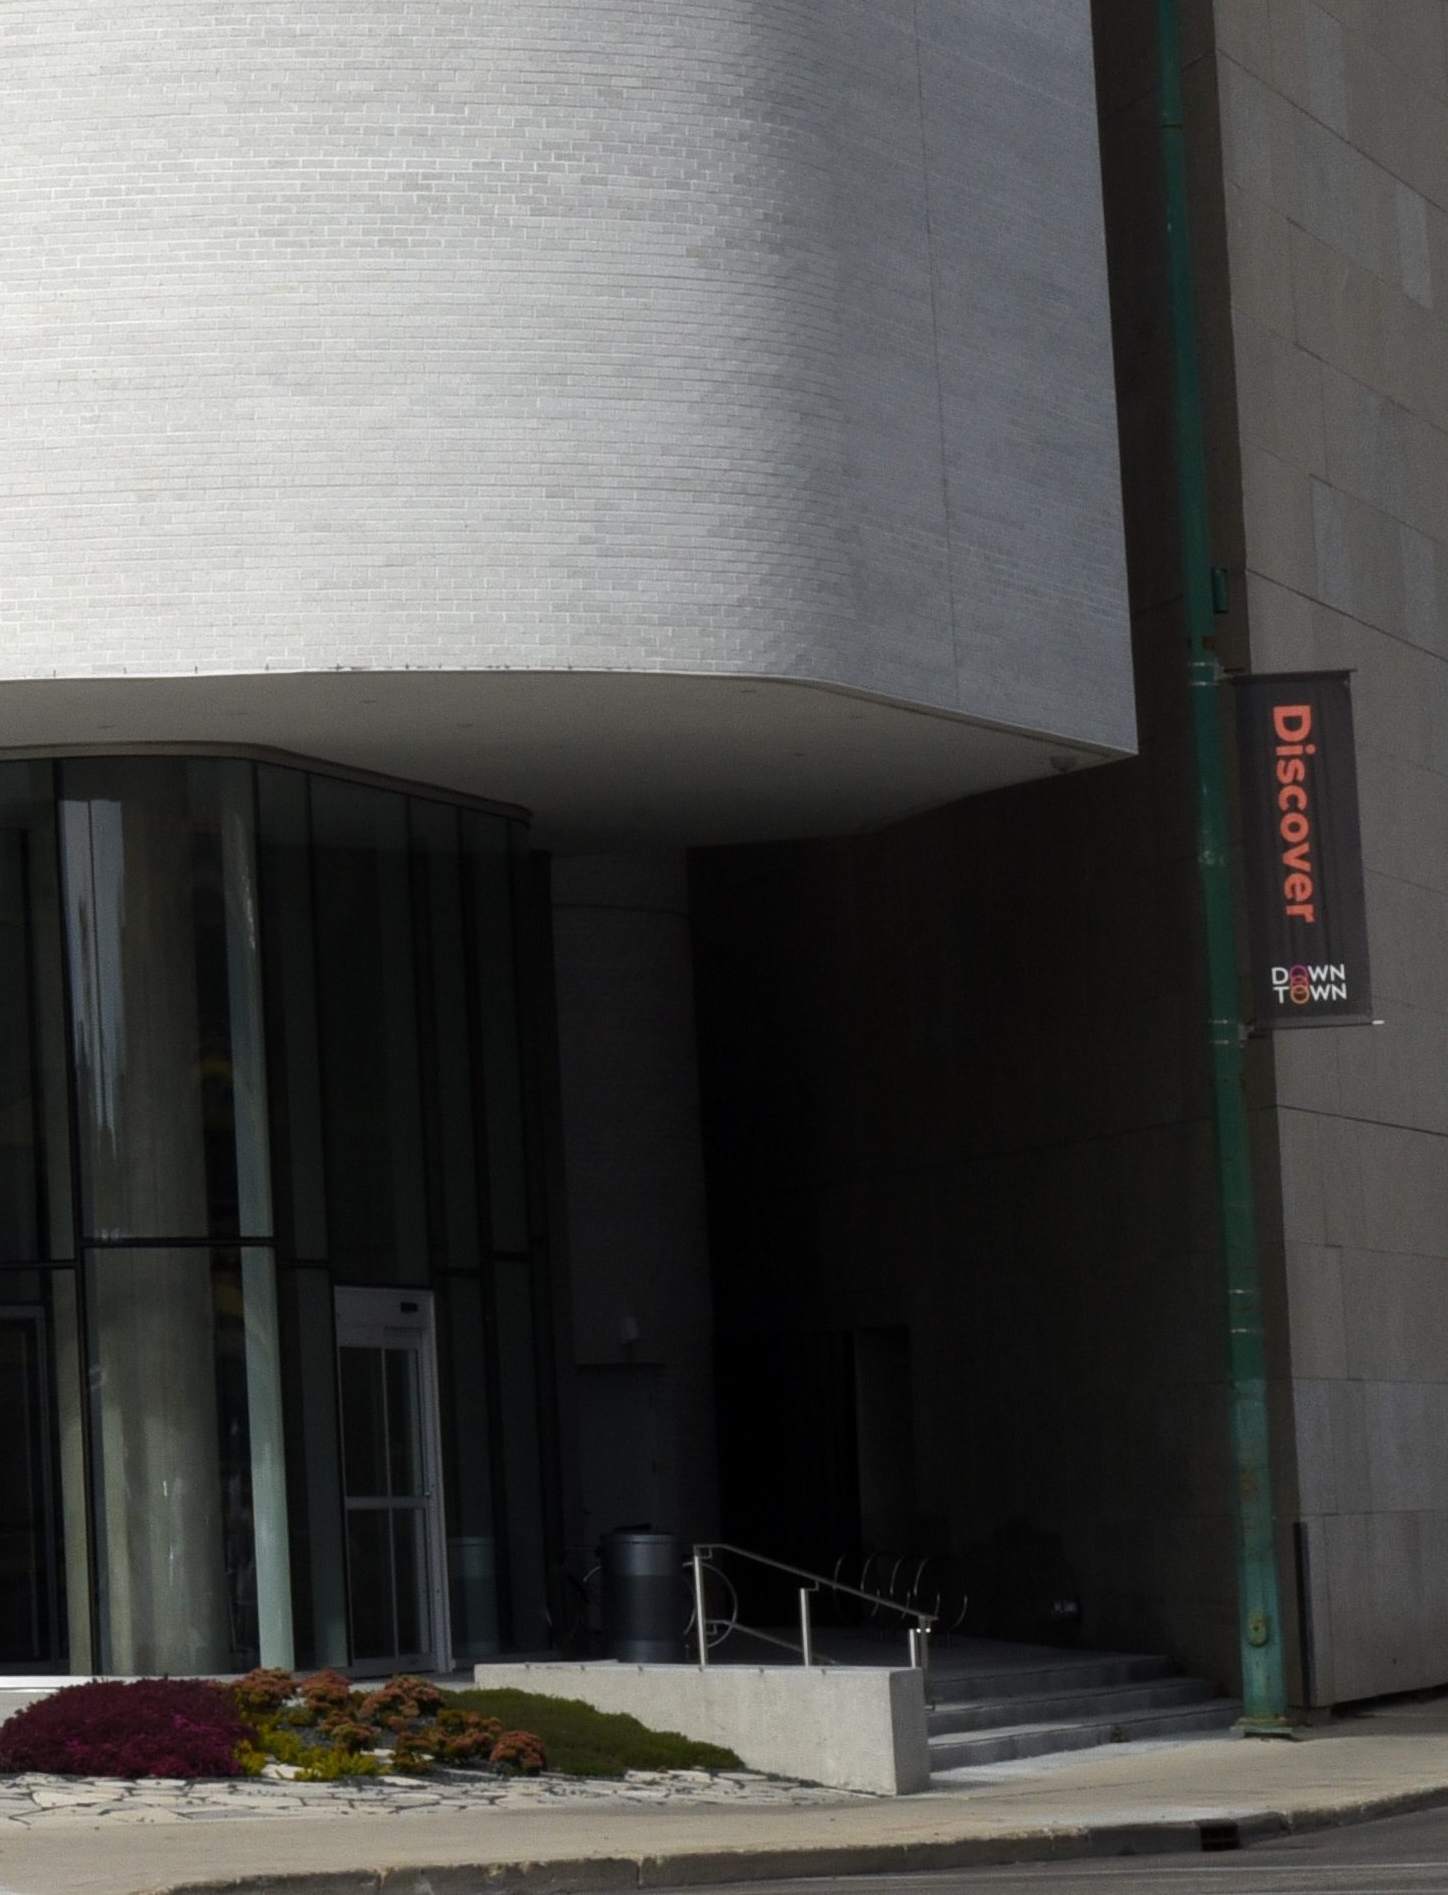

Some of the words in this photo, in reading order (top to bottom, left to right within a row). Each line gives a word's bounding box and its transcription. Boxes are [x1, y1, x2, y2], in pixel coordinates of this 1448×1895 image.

[1272, 705, 1316, 923] Discover
[1271, 963, 1346, 987] DOWN
[1273, 983, 1348, 1004] TOWN
